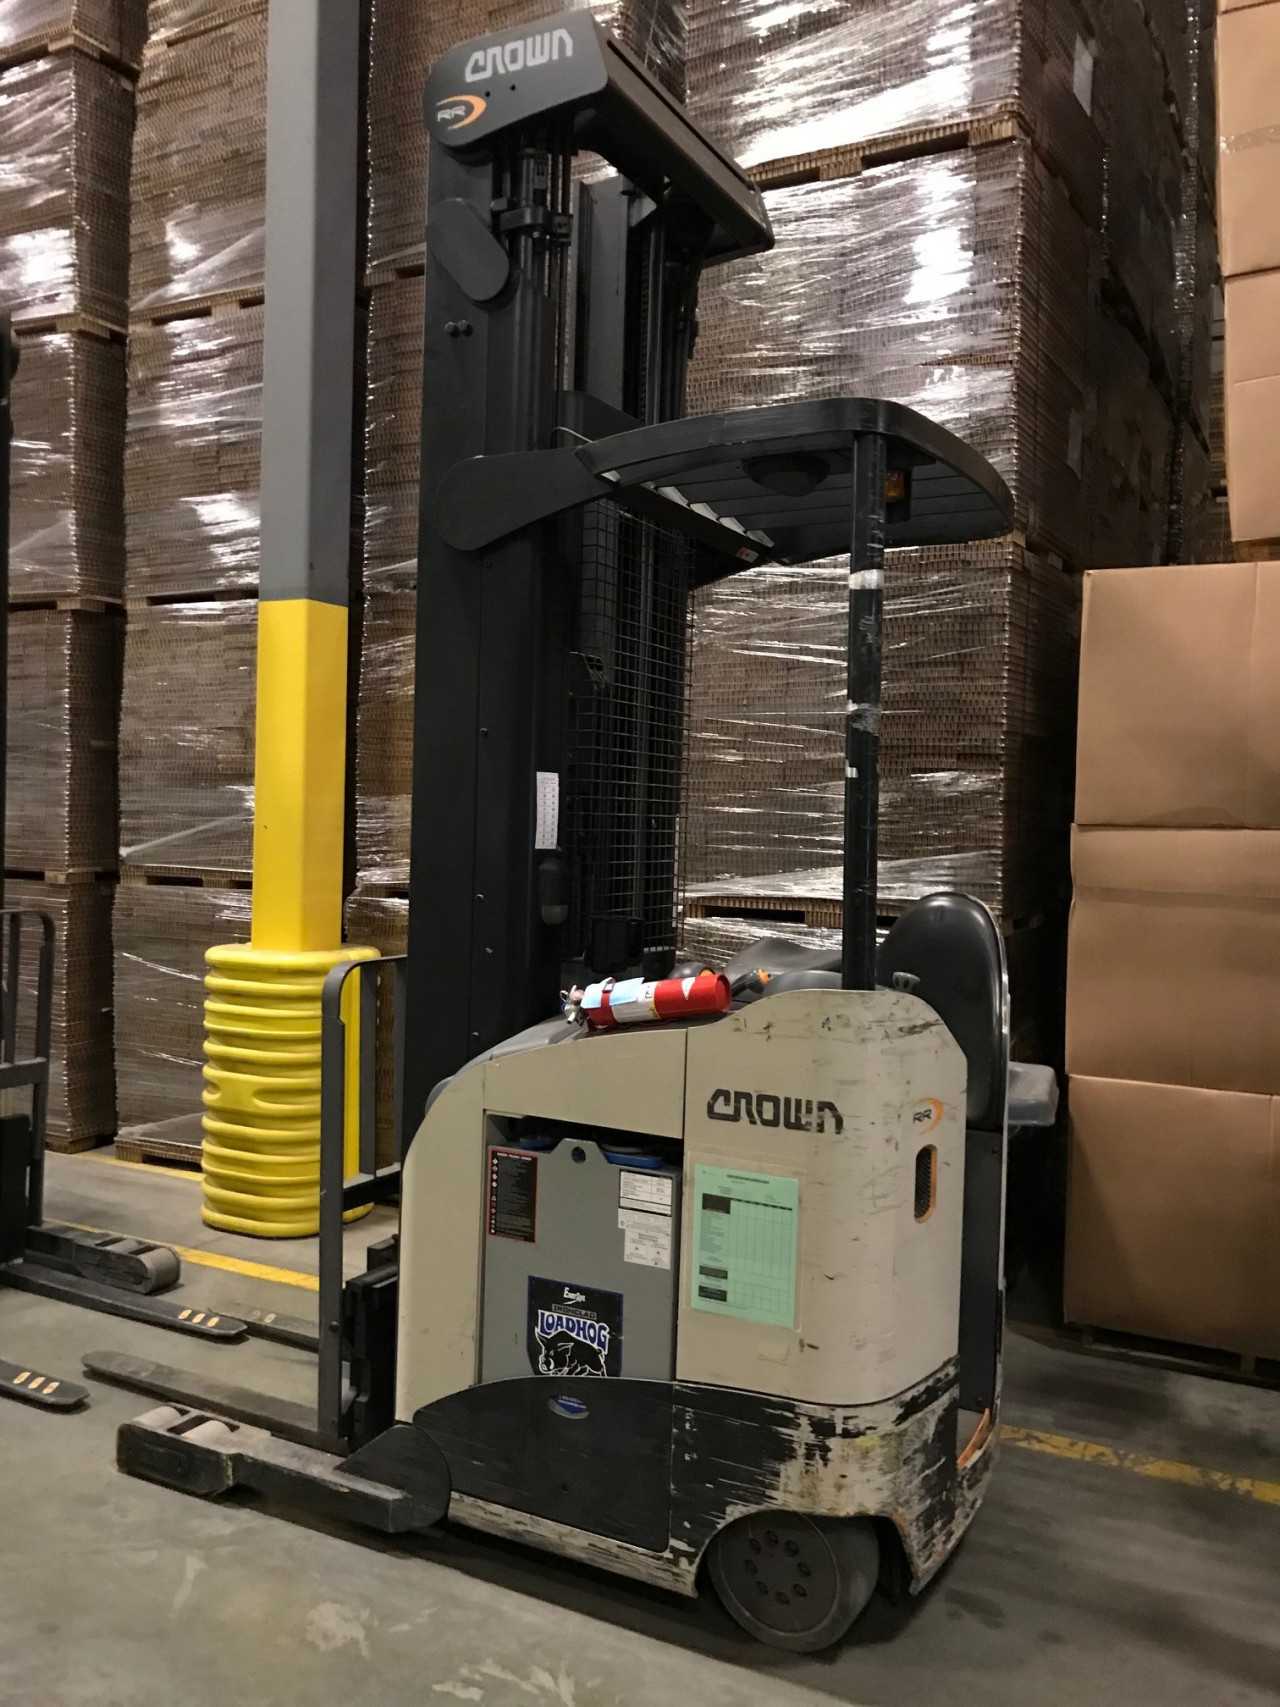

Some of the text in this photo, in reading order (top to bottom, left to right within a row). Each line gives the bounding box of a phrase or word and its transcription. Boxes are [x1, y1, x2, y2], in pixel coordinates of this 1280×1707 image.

[465, 28, 573, 83] CROWN
[707, 1088, 844, 1135] CROWN
[538, 1309, 610, 1355] LOADHOG
